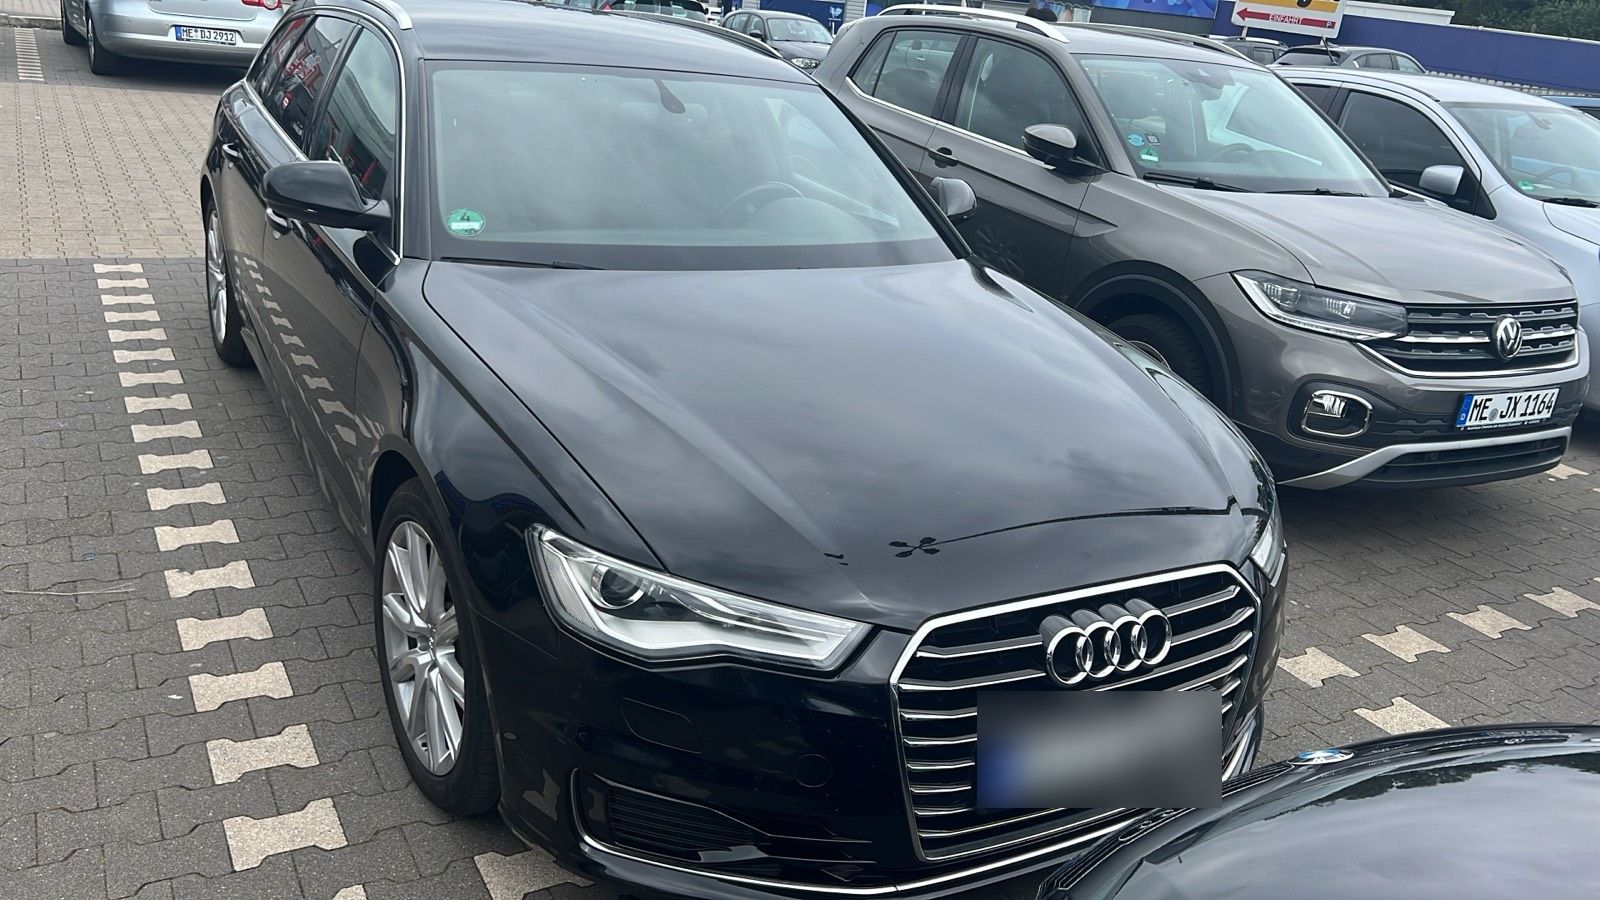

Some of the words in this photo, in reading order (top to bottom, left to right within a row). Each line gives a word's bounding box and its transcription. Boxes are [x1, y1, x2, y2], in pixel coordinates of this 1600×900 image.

[1269, 13, 1303, 25] EINFAHRT
[182, 28, 194, 38] ME
[460, 211, 470, 222] 4
[1469, 398, 1493, 422] ME
[1499, 395, 1522, 419] JX
[1520, 391, 1556, 418] 1164
